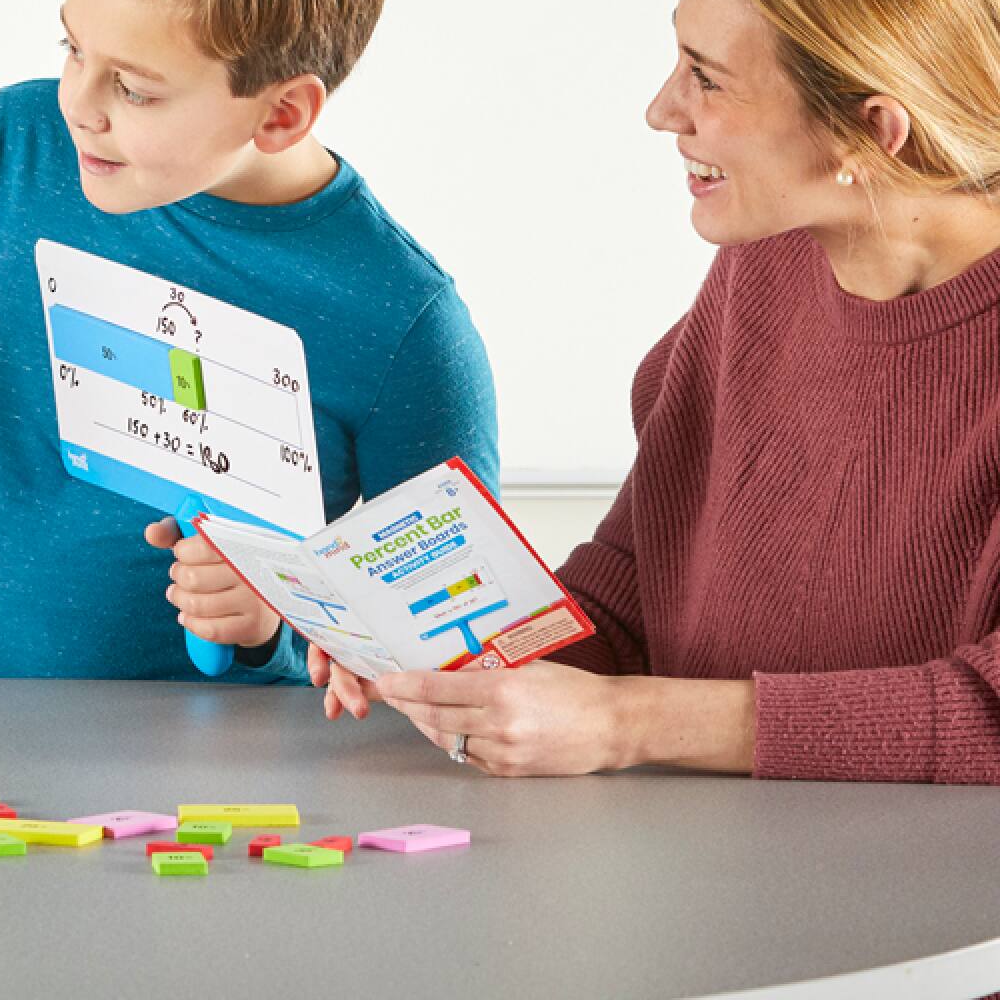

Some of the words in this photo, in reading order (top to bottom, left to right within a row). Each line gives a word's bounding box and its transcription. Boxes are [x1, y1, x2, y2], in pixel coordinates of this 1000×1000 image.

[47, 277, 58, 293] 0
[169, 287, 185, 303] 30
[156, 316, 177, 337] 150
[59, 363, 80, 388] 0%
[271, 367, 301, 393] 300
[141, 391, 167, 414] 50%
[127, 417, 149, 439] 150
[182, 408, 209, 435] 60%
[279, 443, 313, 473] 100%
[350, 523, 429, 569] Percent
[426, 506, 462, 531] Bar
[367, 546, 417, 577] Answer
[417, 521, 469, 551] Boards
